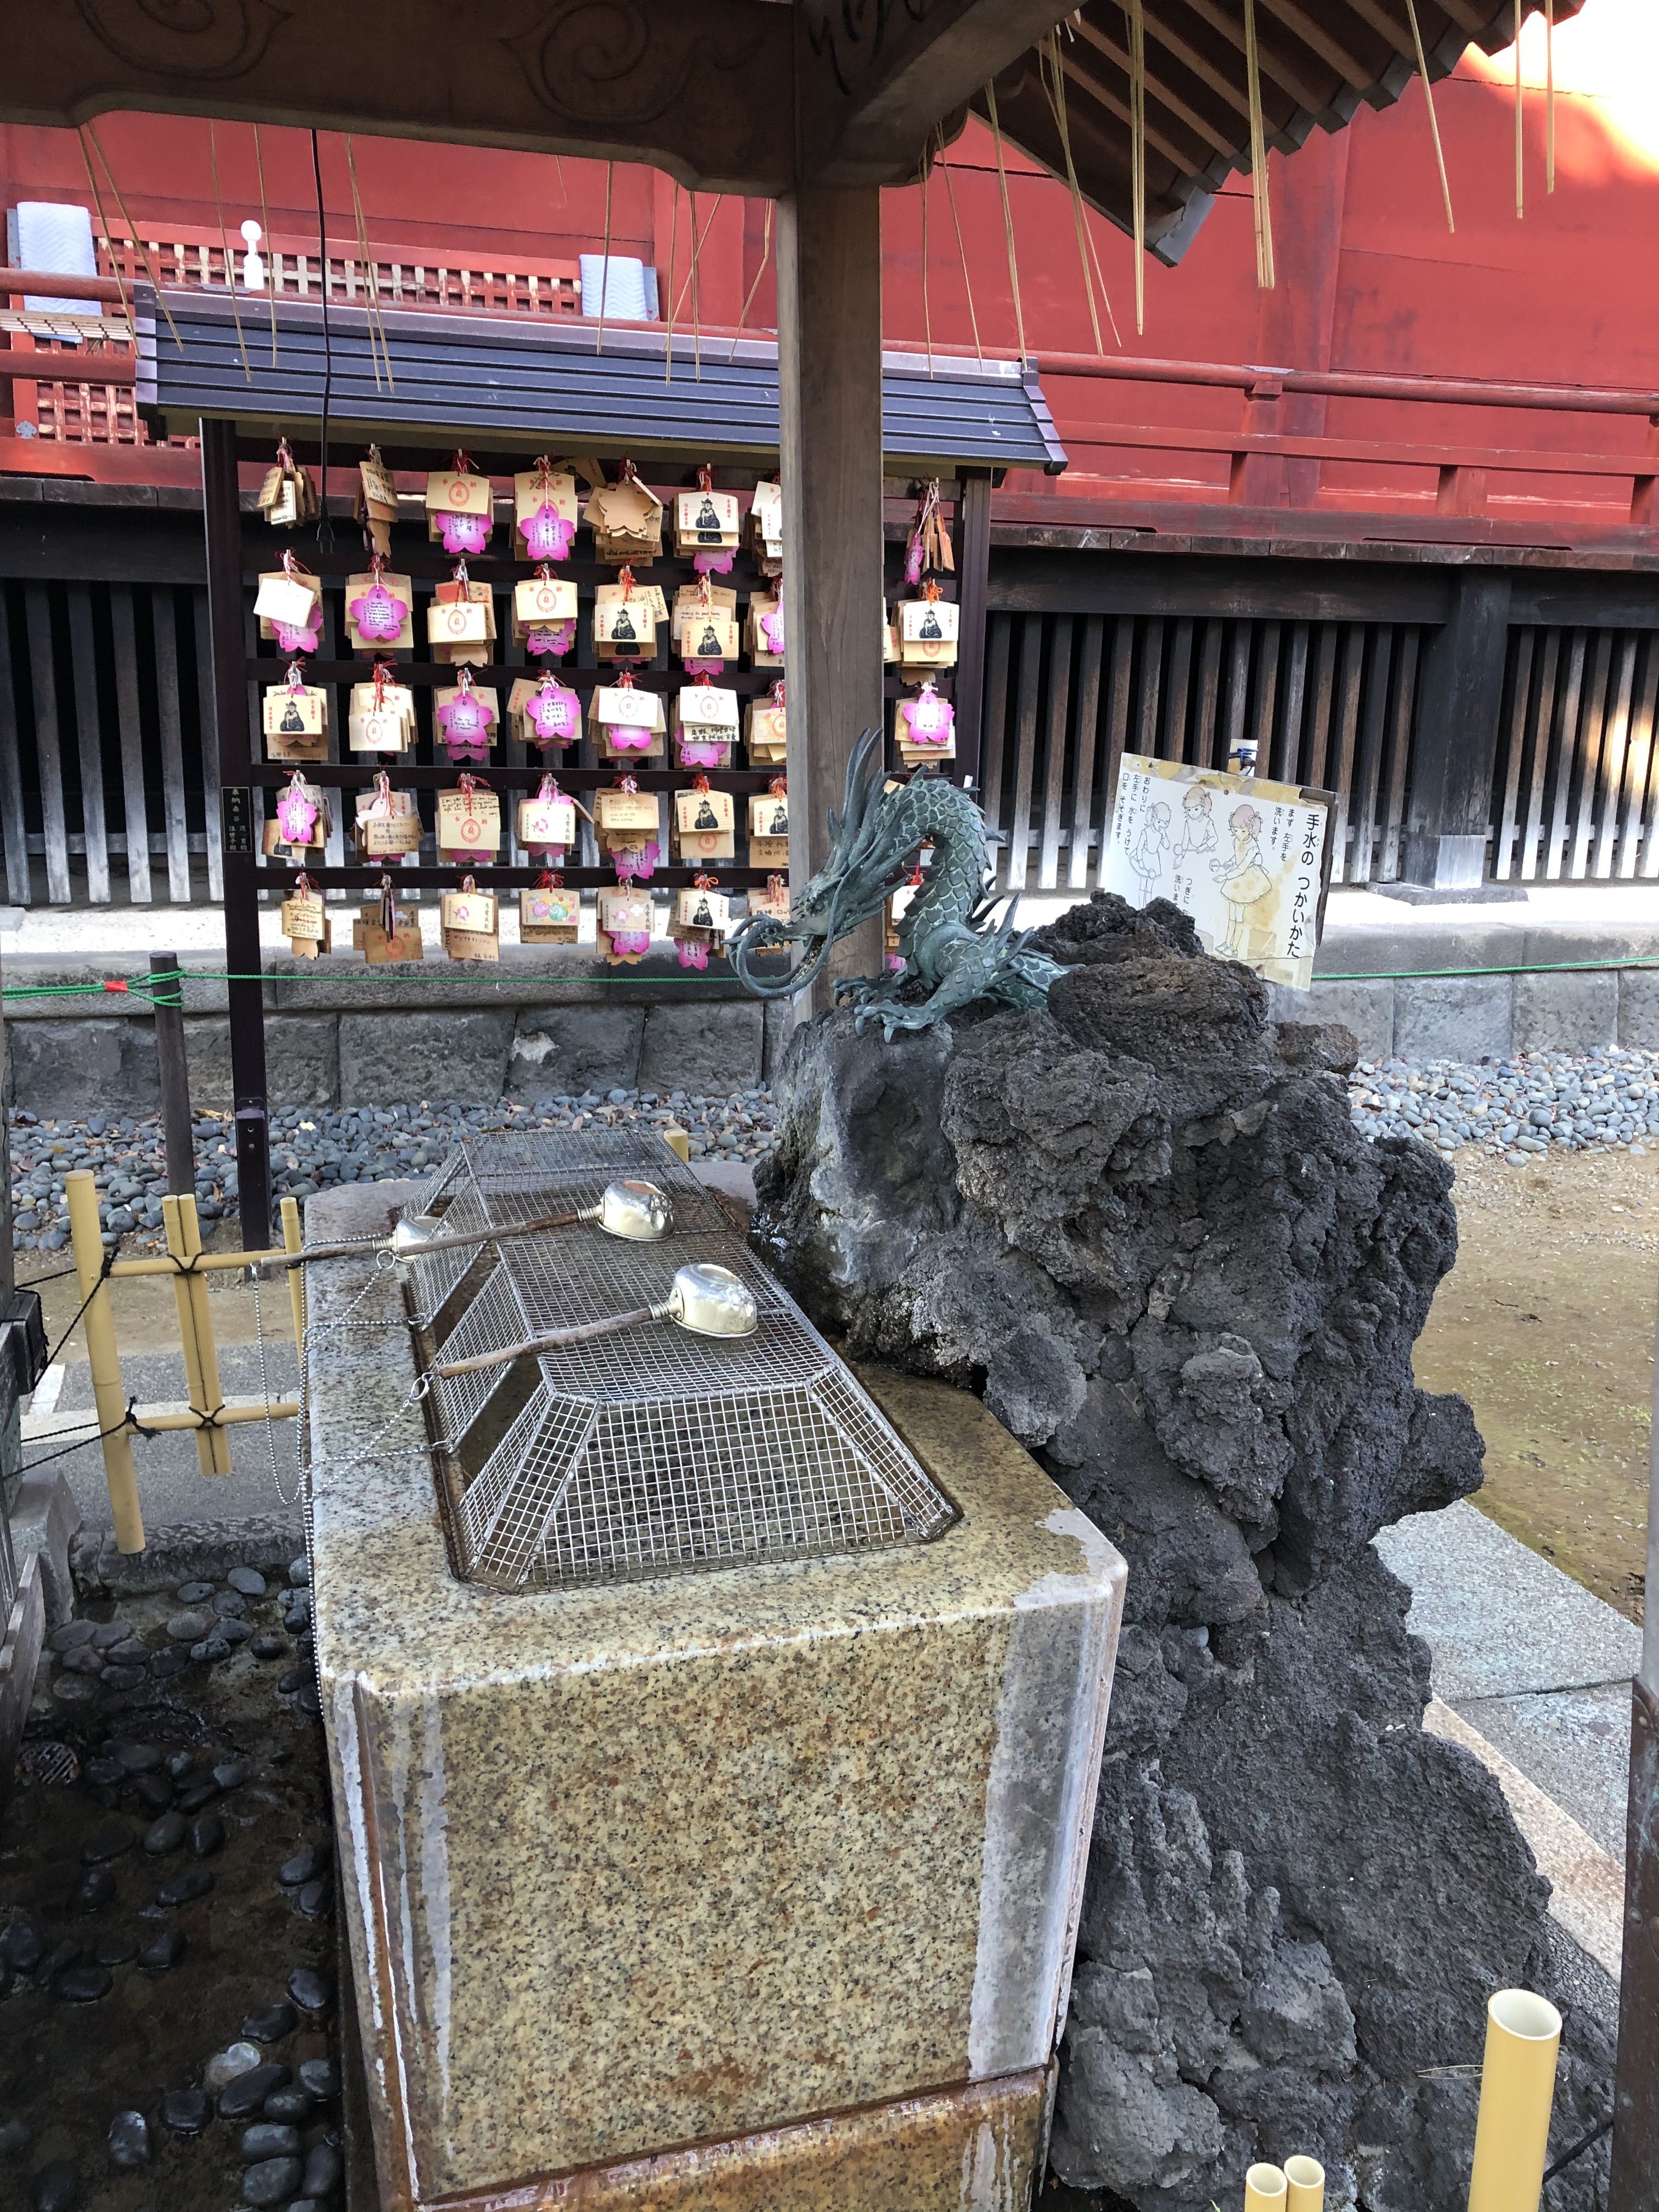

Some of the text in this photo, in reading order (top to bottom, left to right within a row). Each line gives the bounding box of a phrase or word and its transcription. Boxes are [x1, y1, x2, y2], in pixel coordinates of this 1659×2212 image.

[1121, 772, 1129, 791] 口を
[1131, 774, 1140, 802] 左手に
[1139, 776, 1150, 812] おわりに
[1127, 806, 1136, 824] 水を
[1280, 809, 1295, 862] まず 左手を
[1183, 878, 1193, 904] つぎに
[1287, 814, 1319, 958] 手水の つかいかた
